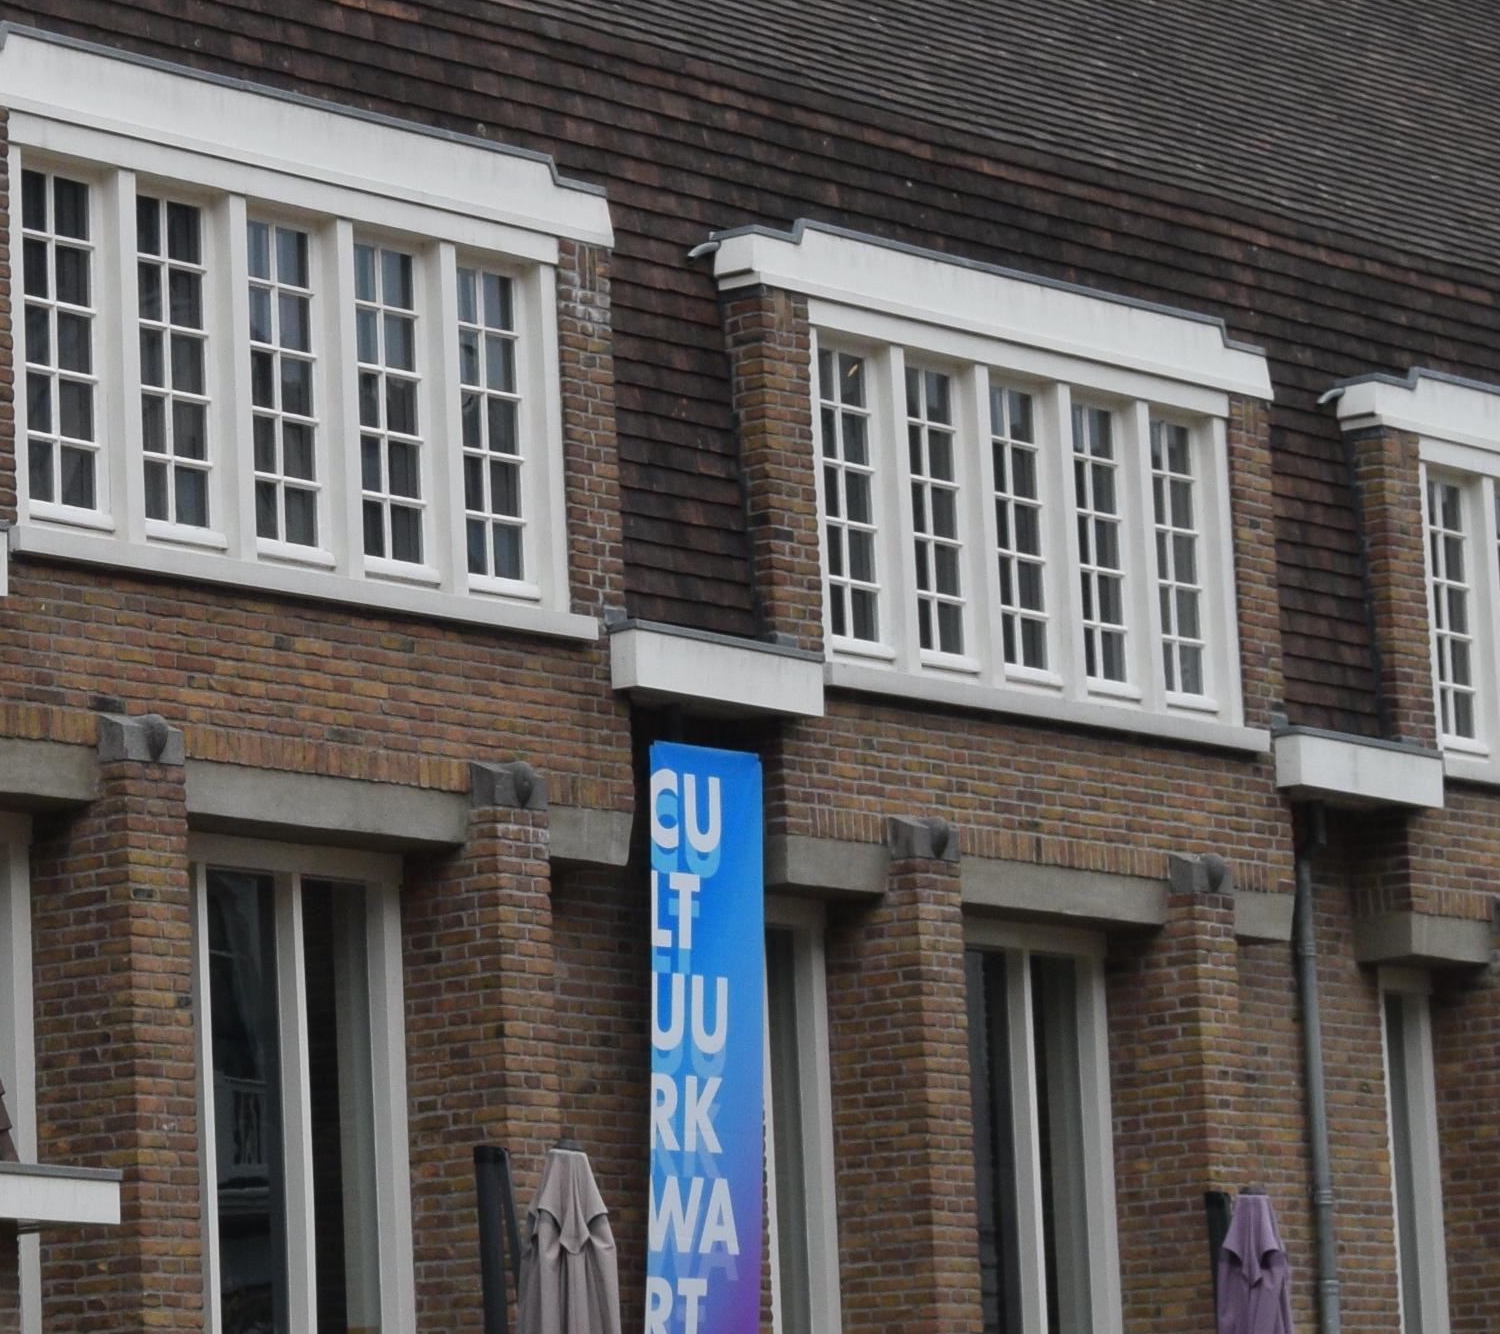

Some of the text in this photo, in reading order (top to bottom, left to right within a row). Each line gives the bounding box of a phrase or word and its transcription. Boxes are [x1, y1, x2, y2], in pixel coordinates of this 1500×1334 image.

[651, 769, 721, 852] CU
[651, 870, 700, 949] LT
[652, 971, 728, 1054] UU
[650, 1072, 722, 1153] RK
[649, 1176, 739, 1255] WA
